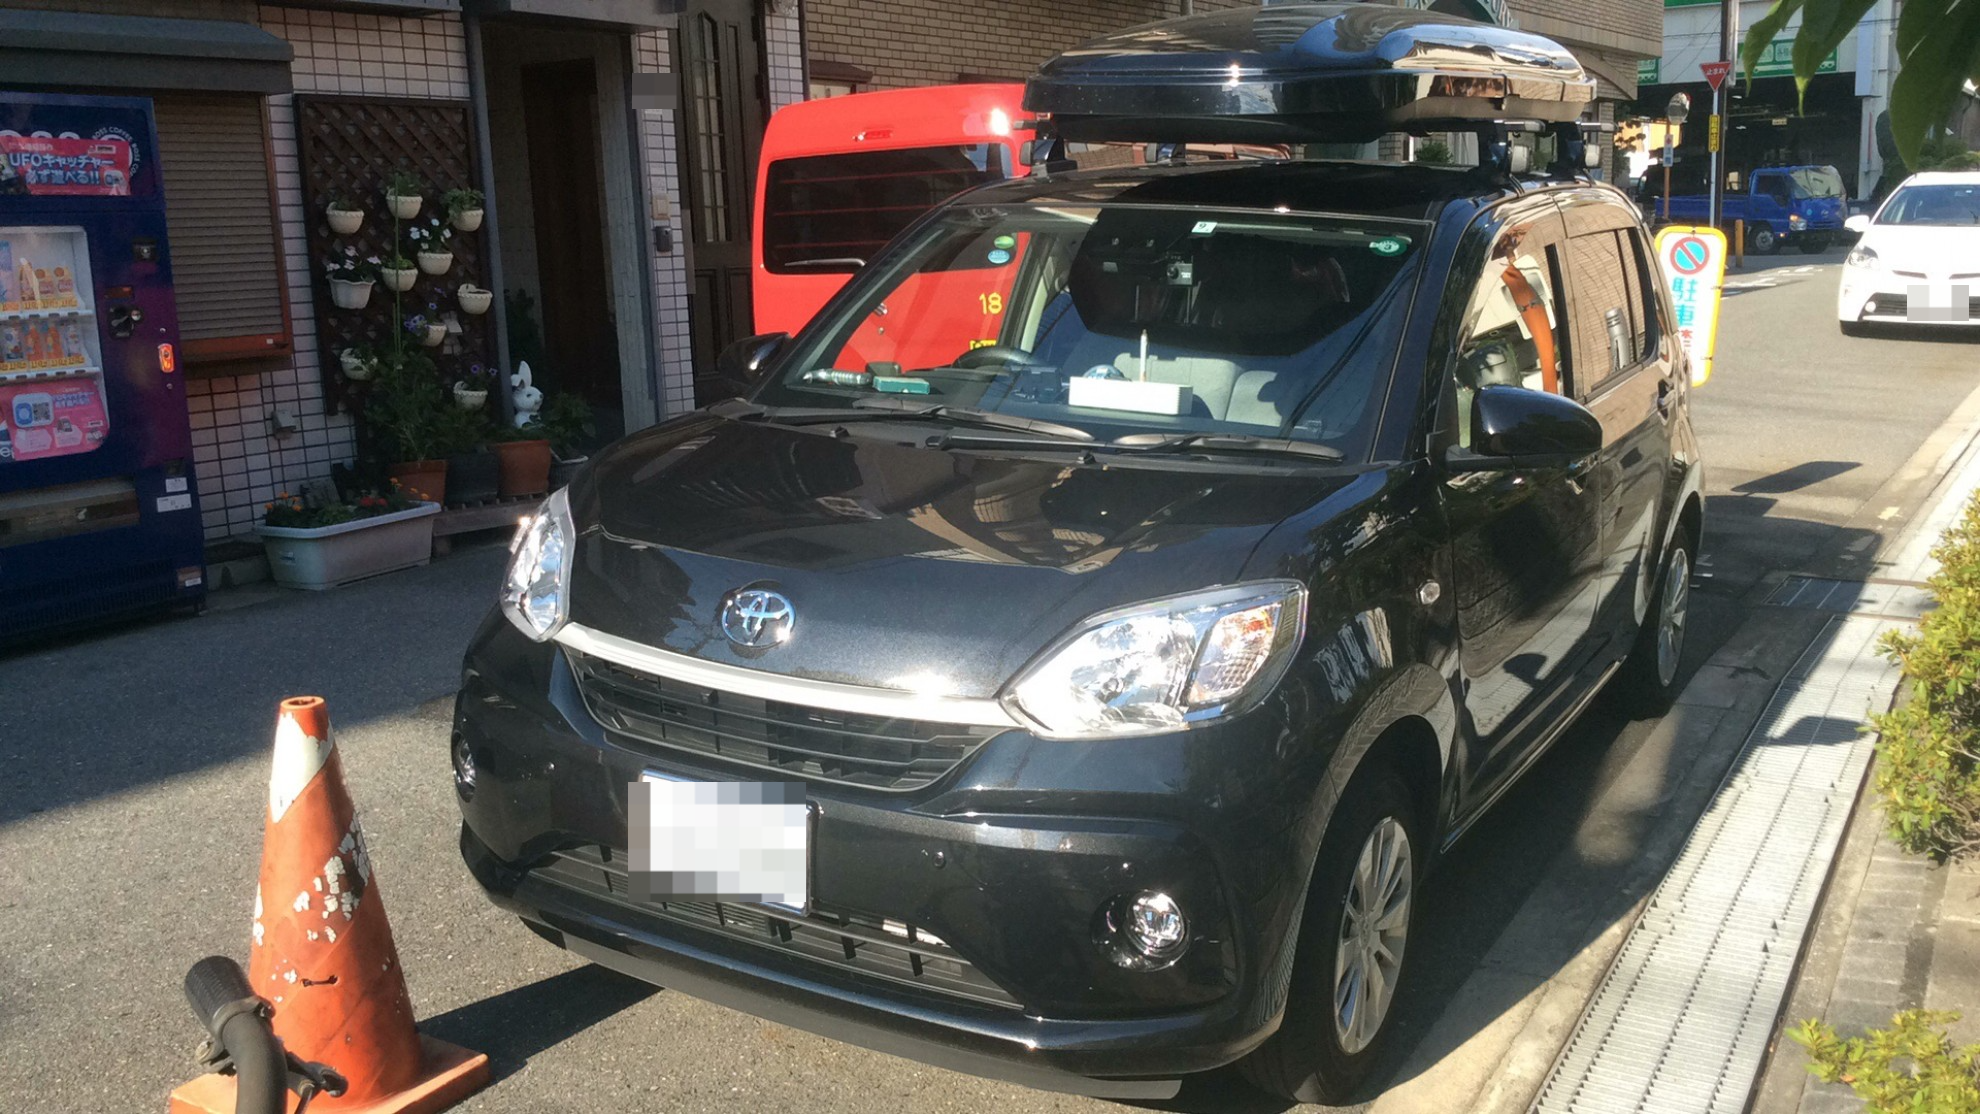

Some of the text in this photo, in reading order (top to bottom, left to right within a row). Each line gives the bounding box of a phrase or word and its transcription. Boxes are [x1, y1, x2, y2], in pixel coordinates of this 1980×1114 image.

[1706, 67, 1726, 76] 止まれ
[9, 152, 115, 168] UFOキャッチャー
[979, 292, 1002, 315] 18
